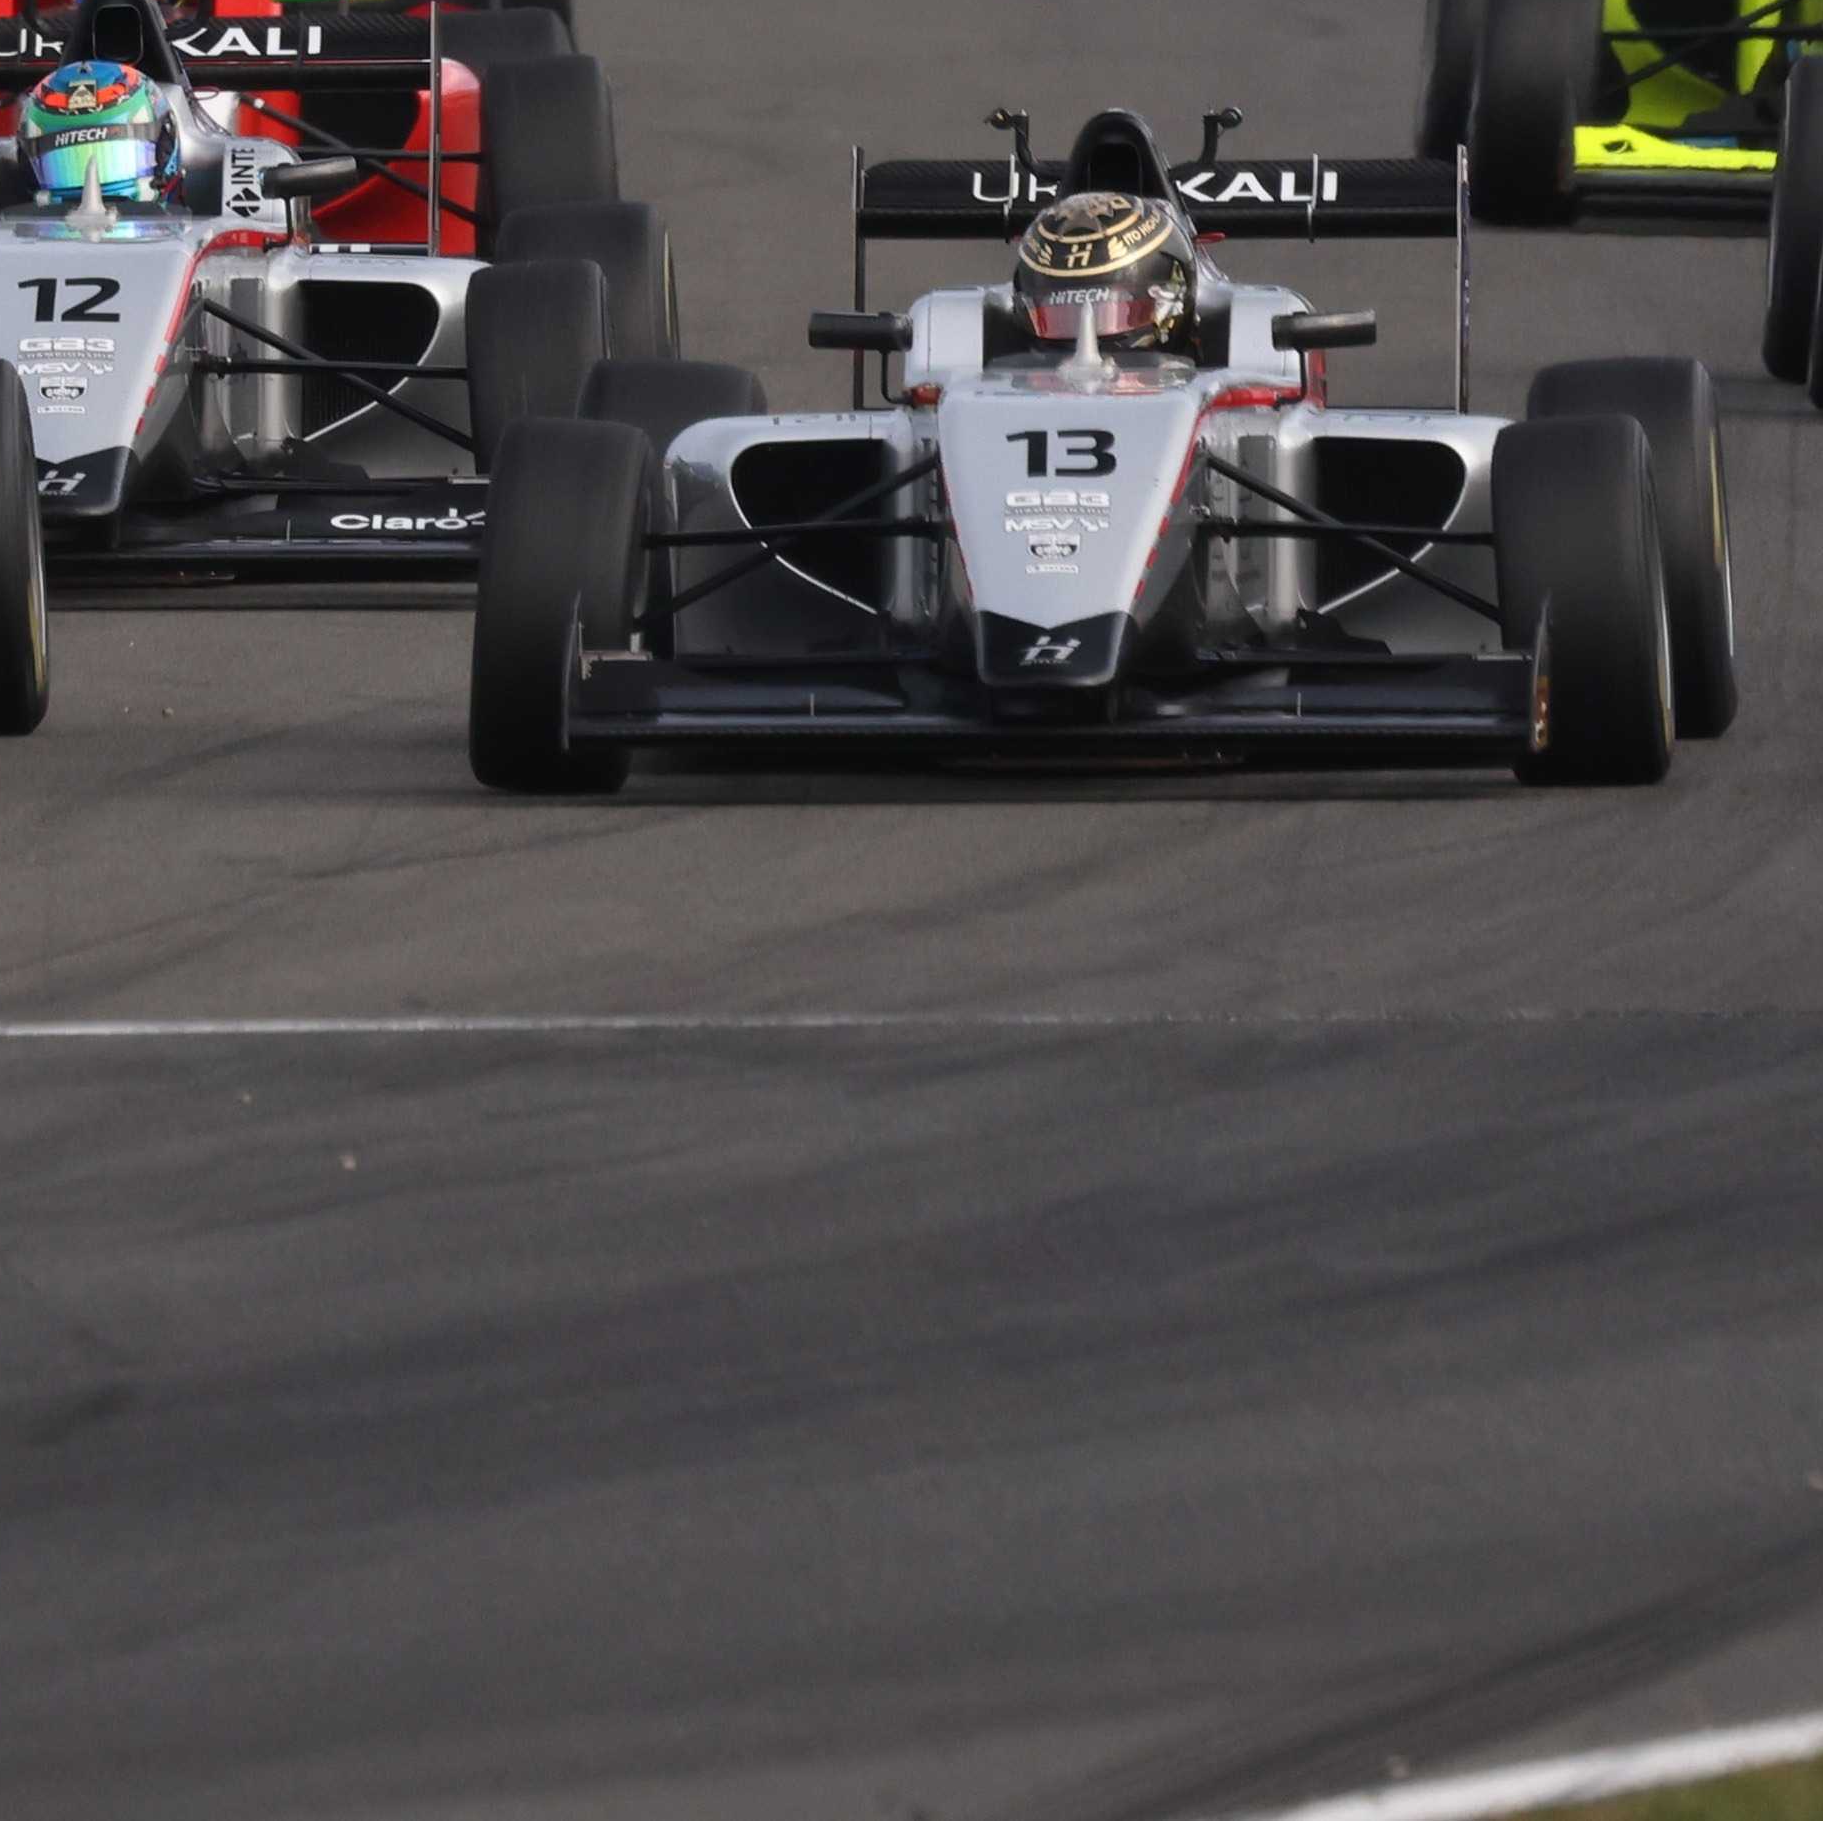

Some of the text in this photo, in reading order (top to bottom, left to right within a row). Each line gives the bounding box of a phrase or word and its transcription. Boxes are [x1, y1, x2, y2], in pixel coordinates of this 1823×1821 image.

[54, 127, 108, 148] HITECH
[18, 277, 121, 322] 12
[1048, 287, 1110, 306] HITECH
[19, 337, 115, 352] GB3
[18, 362, 82, 376] MSV
[1006, 430, 1118, 478] 13
[1005, 492, 1111, 508] GB3
[1005, 518, 1075, 532] MSV
